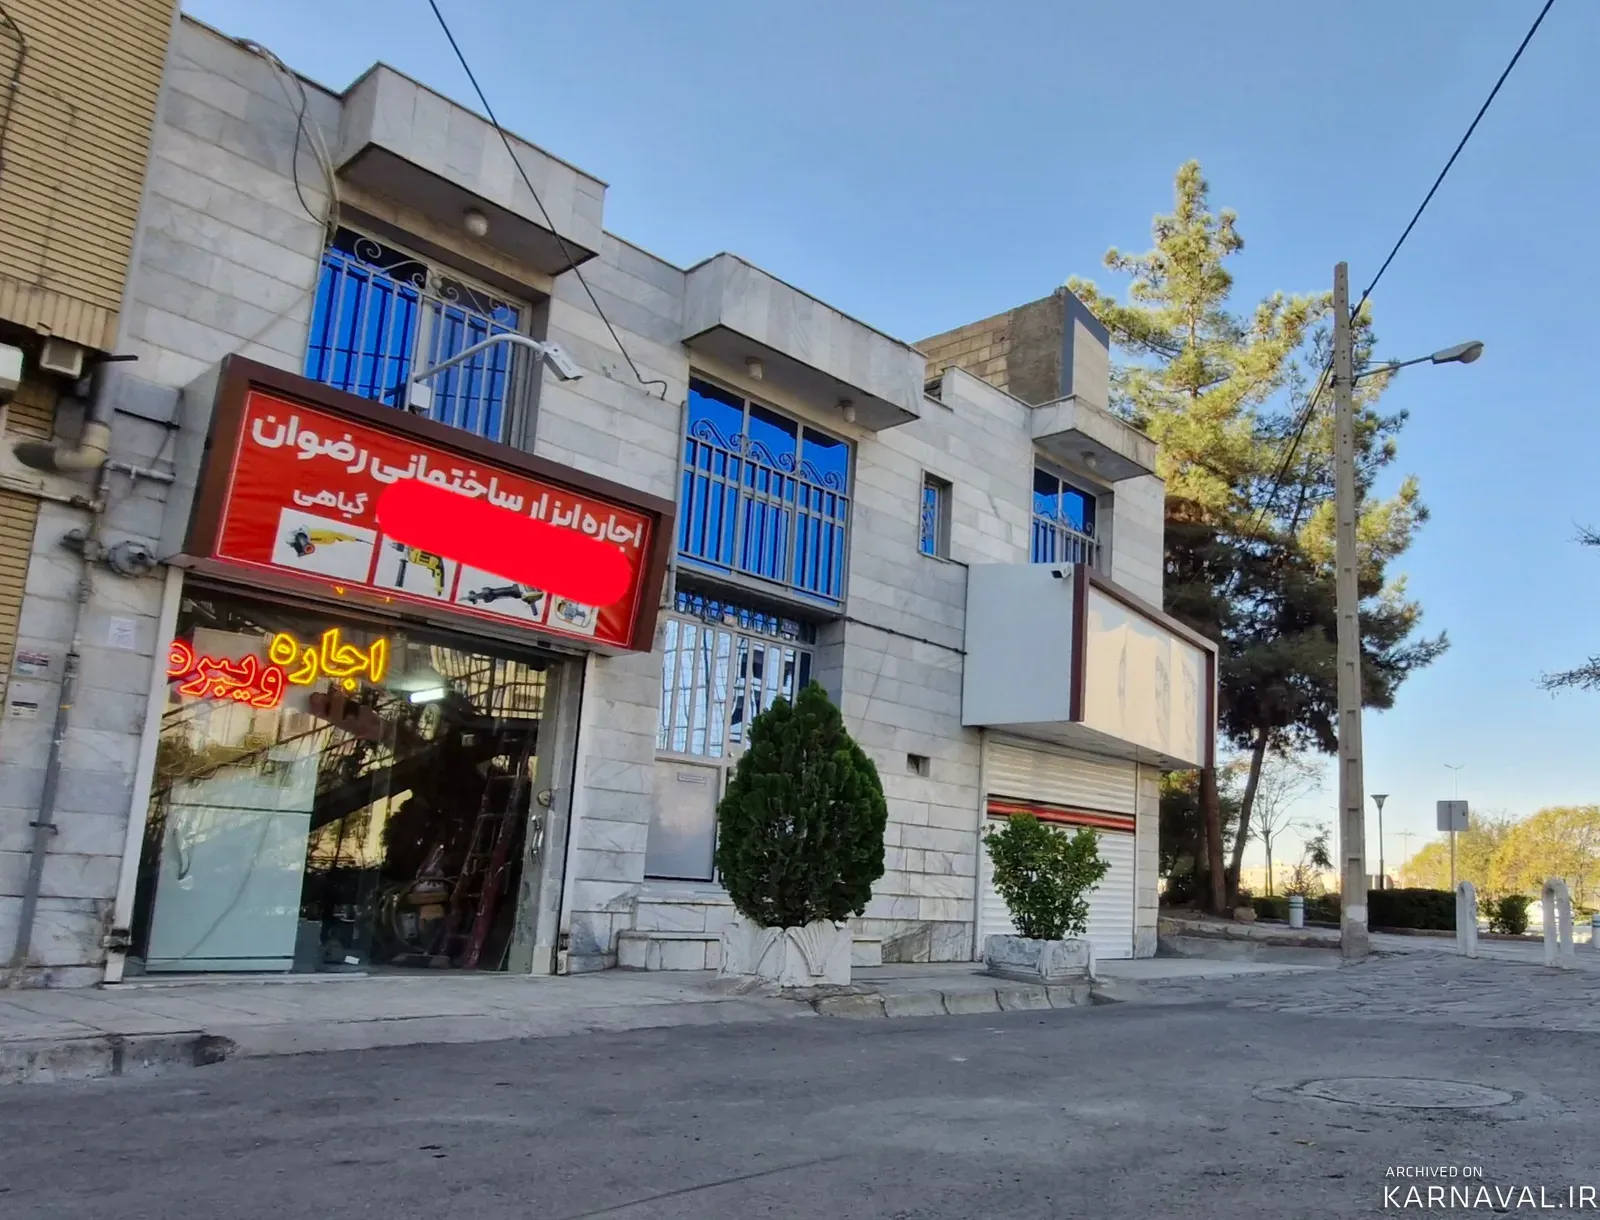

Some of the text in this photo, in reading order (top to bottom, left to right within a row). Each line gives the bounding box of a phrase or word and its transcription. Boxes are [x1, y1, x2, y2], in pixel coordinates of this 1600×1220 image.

[252, 415, 368, 474] رضوان
[293, 489, 369, 519] گیاهی
[370, 454, 524, 512] ساختمانی
[582, 514, 643, 553] اجاره
[167, 641, 284, 708] ویبره
[270, 628, 386, 690] اجاره
